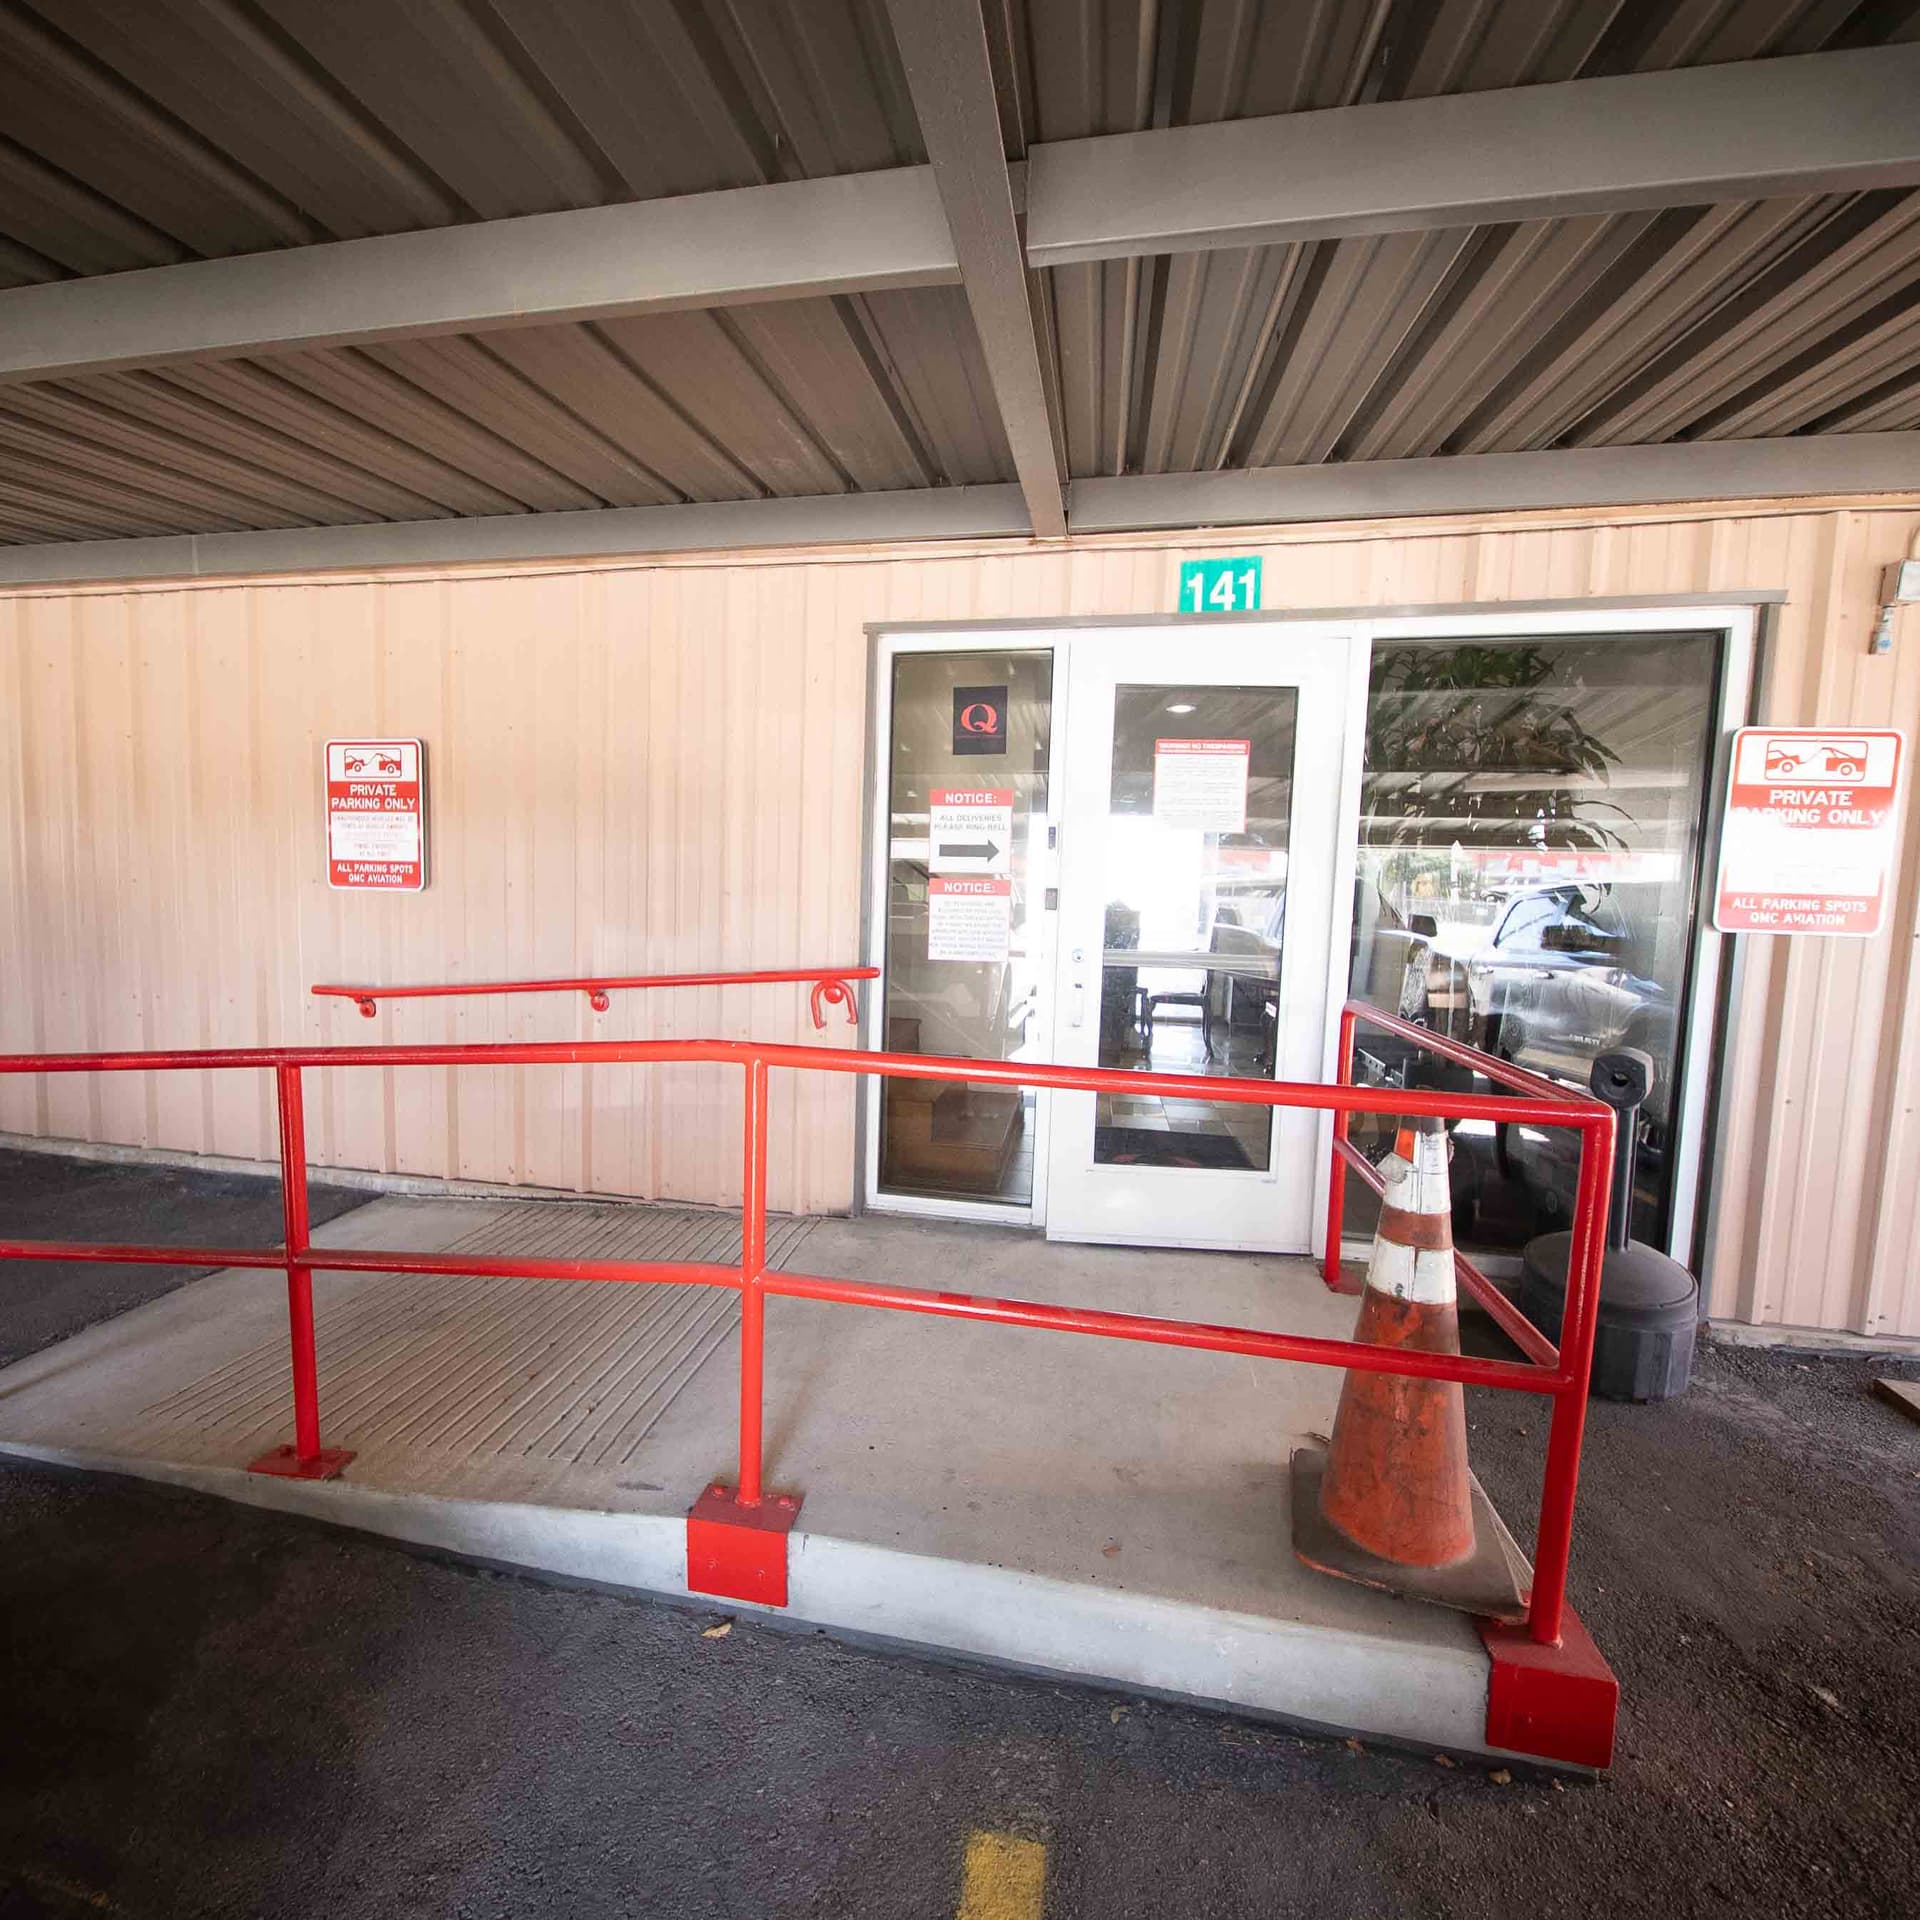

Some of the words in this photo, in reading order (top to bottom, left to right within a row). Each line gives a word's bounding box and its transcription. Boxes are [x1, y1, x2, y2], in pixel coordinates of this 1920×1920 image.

[1187, 569, 1256, 613] 141
[960, 703, 998, 735] Q
[350, 784, 396, 796] PRIVATE
[331, 797, 380, 809] PARKING
[384, 798, 415, 810] ONLY
[945, 792, 997, 804] NOTICE:
[1769, 789, 1853, 806] PRIVATE
[956, 814, 1002, 822] DELIVERIES
[1827, 809, 1884, 826] ONLY
[337, 863, 352, 873] ALL
[354, 864, 388, 874] PARKING
[389, 865, 413, 875] SPOTS
[367, 874, 402, 884] AVIATION
[944, 882, 996, 893] NOTICE:
[1733, 897, 1757, 909] ALL
[1762, 898, 1820, 911] PARKING
[1825, 900, 1868, 913] SPOTS
[1783, 913, 1846, 926] AVIATION
